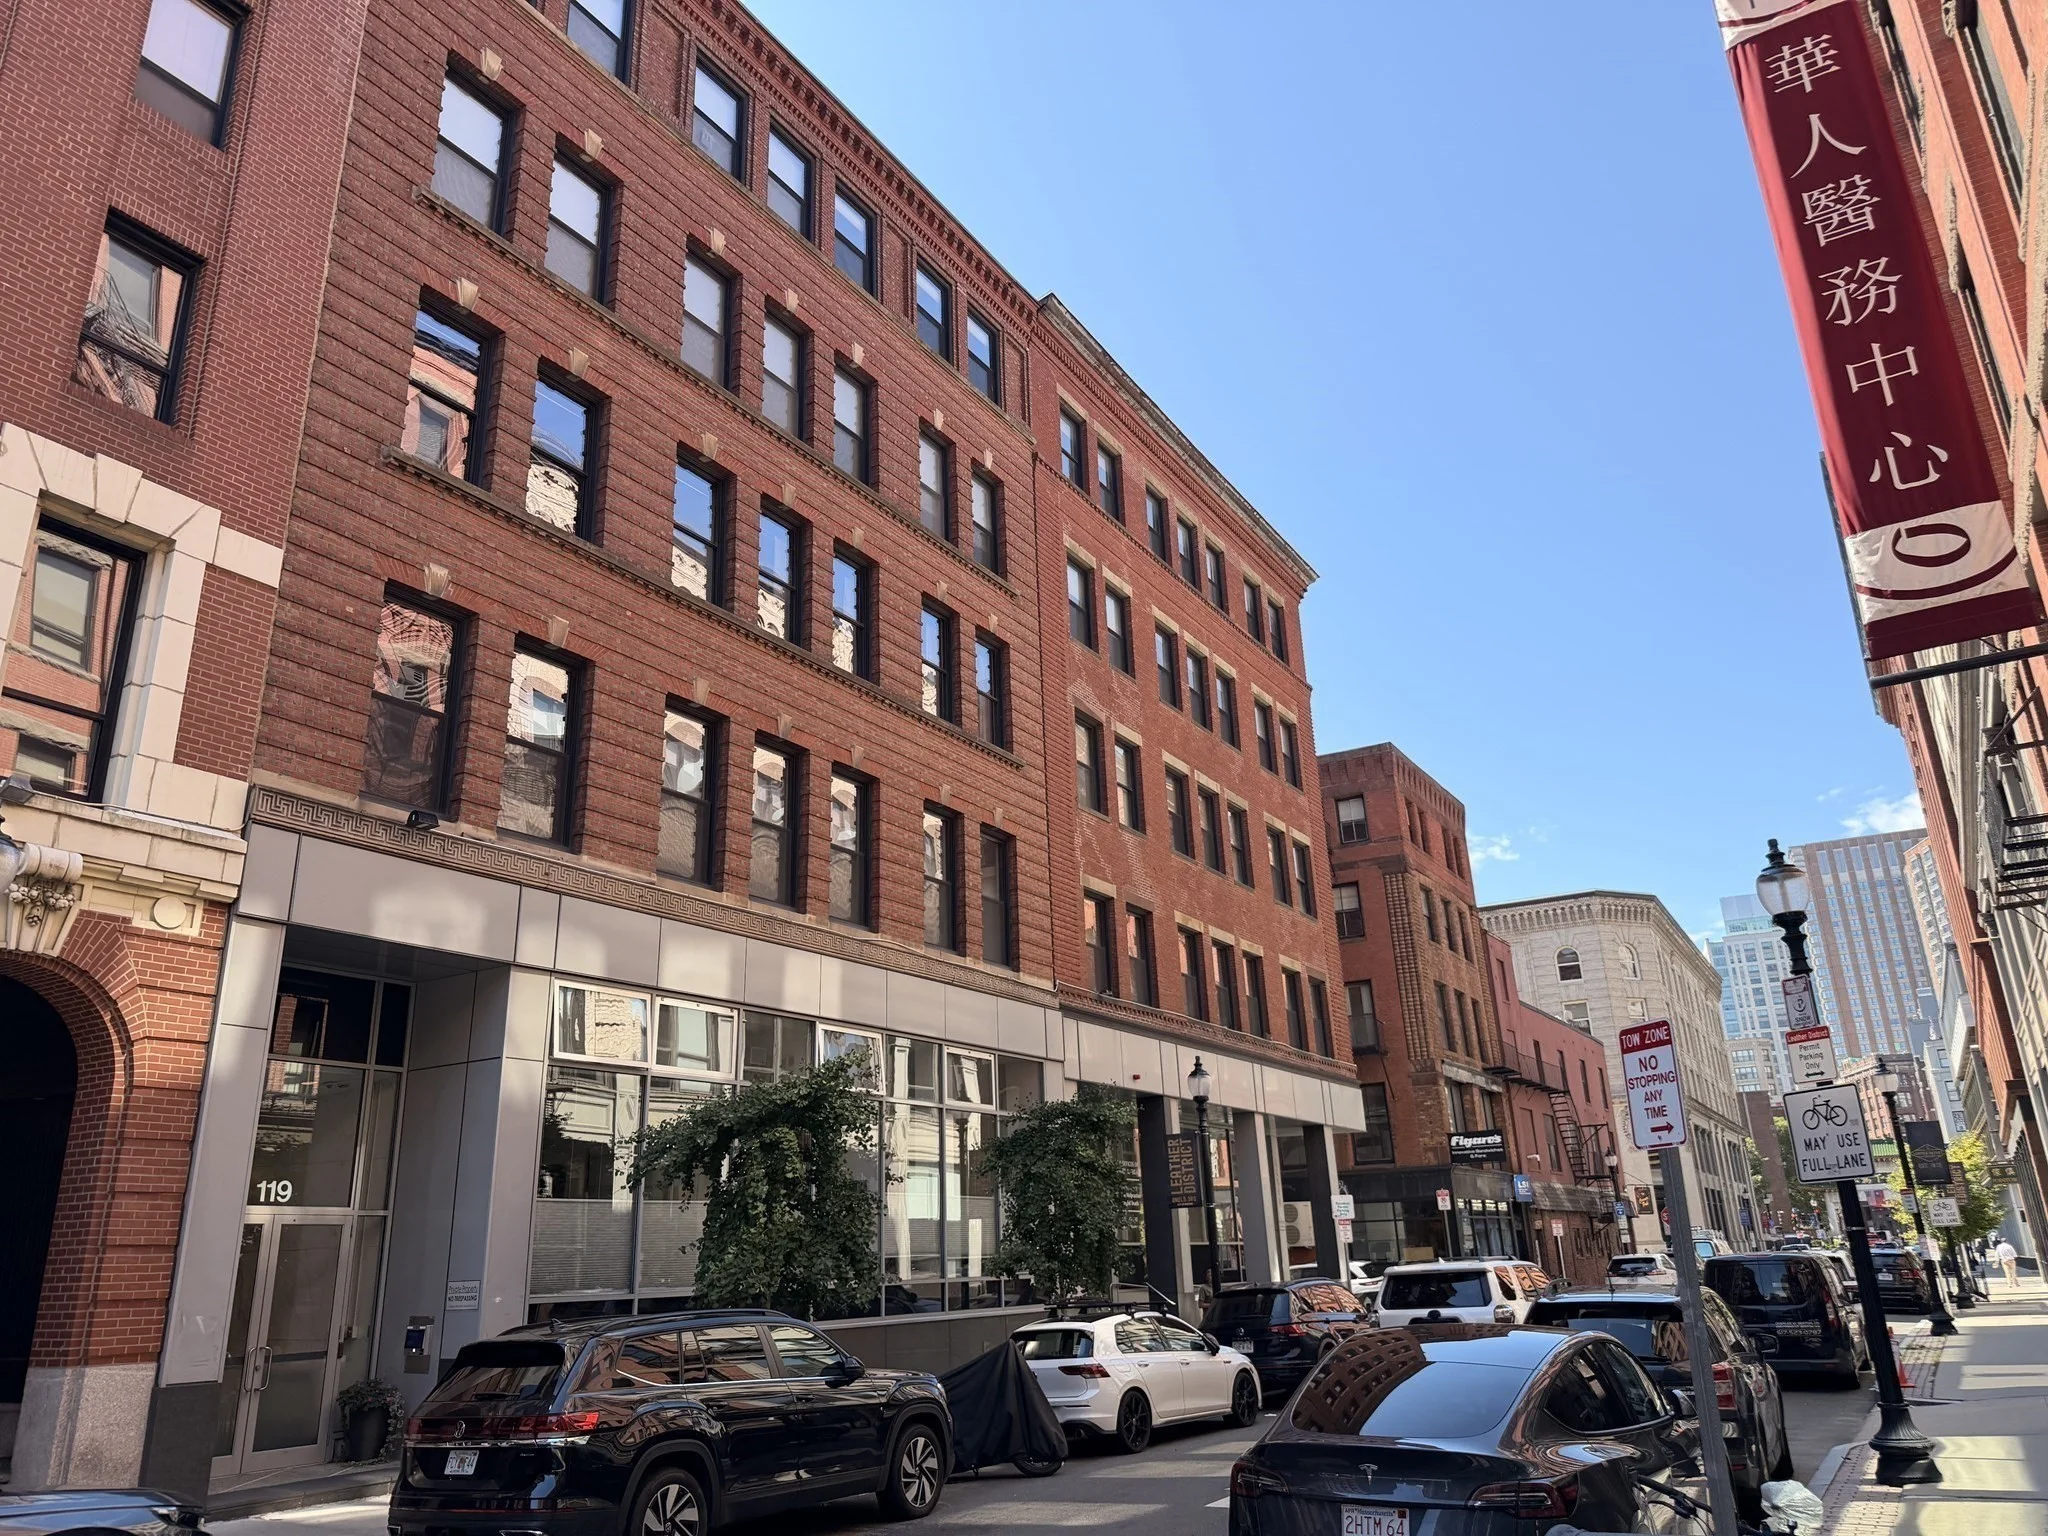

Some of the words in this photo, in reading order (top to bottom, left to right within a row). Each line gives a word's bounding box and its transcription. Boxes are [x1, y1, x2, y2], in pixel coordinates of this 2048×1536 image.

[1765, 32, 1949, 491] 華人醫務中心
[1621, 1032, 1640, 1050] TOW
[1643, 1026, 1670, 1044] ZONE
[1787, 1031, 1808, 1043] Leather
[1808, 1029, 1829, 1040] District
[1799, 1043, 1821, 1052] Permit
[1799, 1051, 1824, 1062] Parking
[1638, 1055, 1659, 1073] NO
[1805, 1061, 1820, 1070] Only
[1628, 1070, 1676, 1090] STOPPING
[1644, 1089, 1663, 1104] ANY
[1644, 1105, 1668, 1120] TIME
[1450, 1134, 1502, 1148] Figaro's
[1803, 1136, 1826, 1152] MAY
[1836, 1132, 1861, 1148] USE
[1167, 1138, 1183, 1195] LEATHER
[1180, 1138, 1197, 1194] DISTRICT
[1802, 1156, 1831, 1173] FULL
[1836, 1153, 1867, 1169] LANE
[256, 1180, 293, 1203] 119
[1345, 1515, 1382, 1536] 2HTM
[1386, 1518, 1405, 1536] 64
